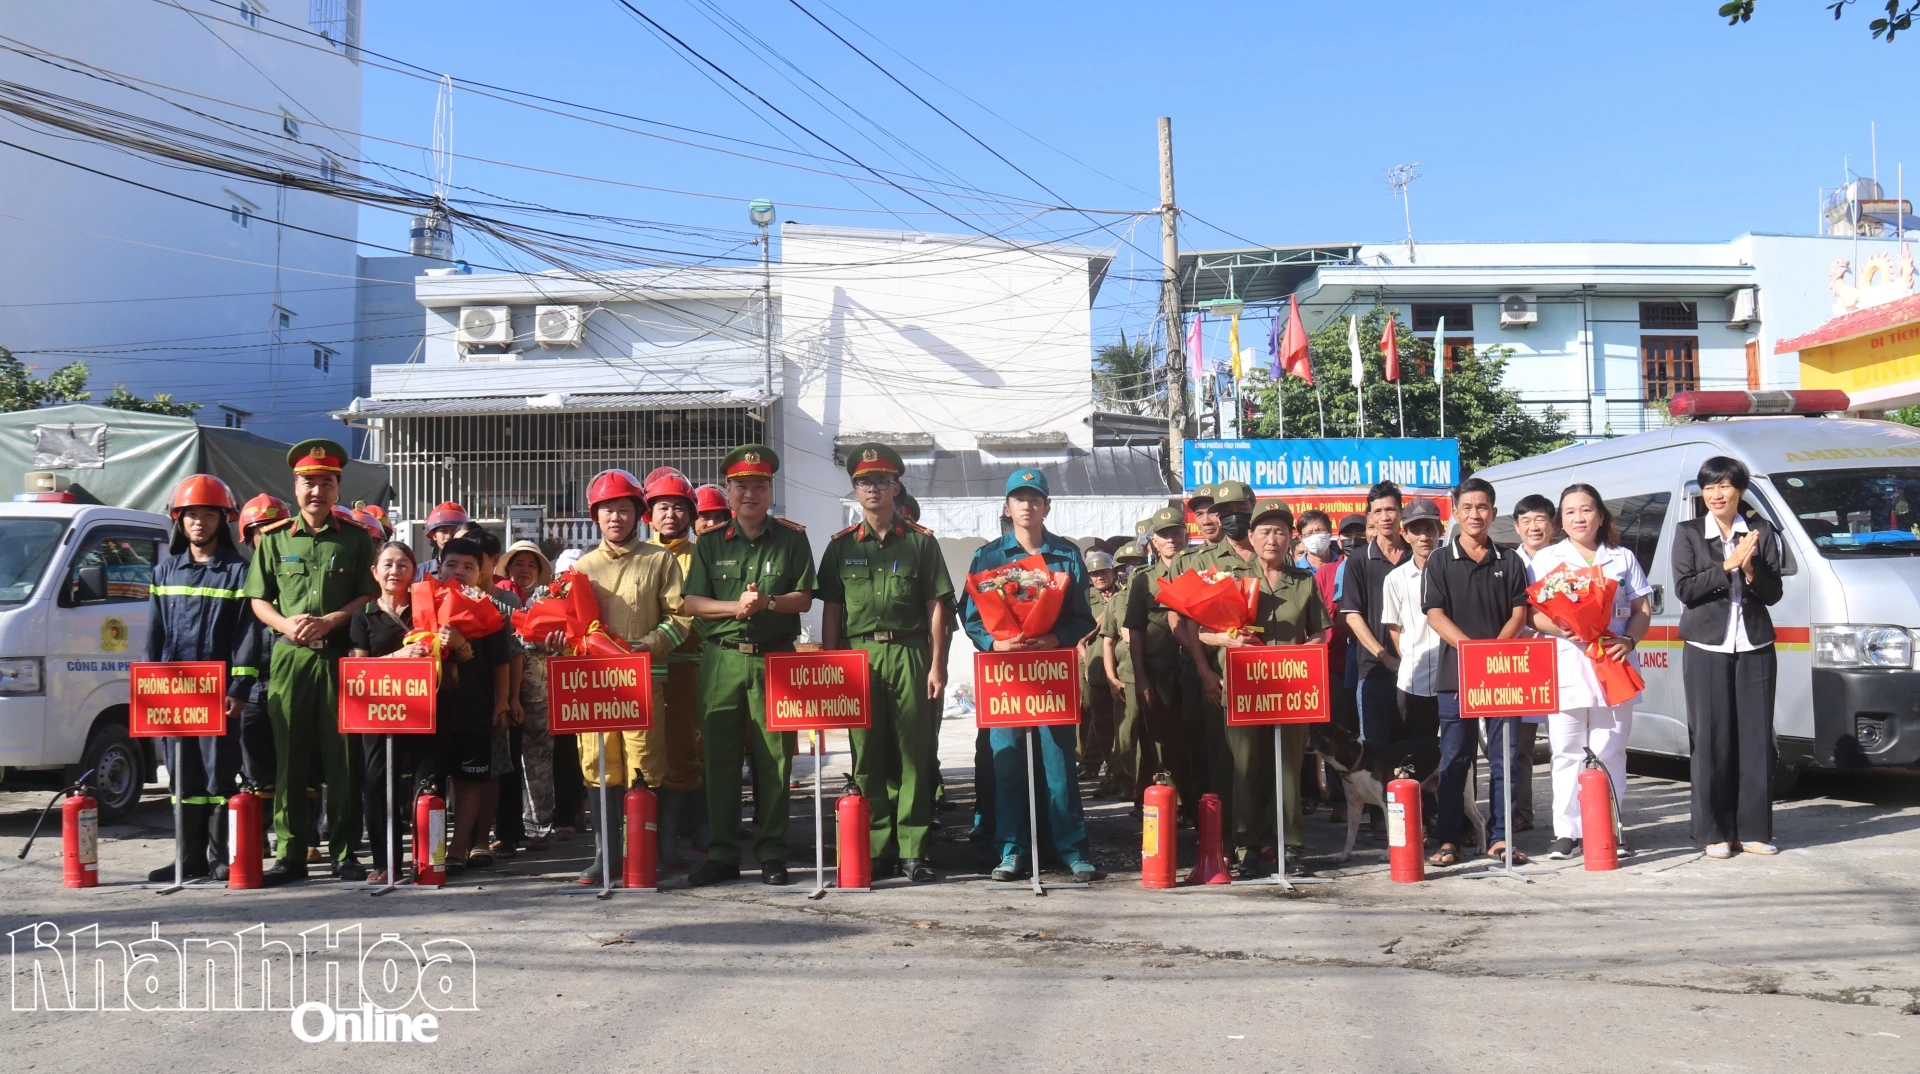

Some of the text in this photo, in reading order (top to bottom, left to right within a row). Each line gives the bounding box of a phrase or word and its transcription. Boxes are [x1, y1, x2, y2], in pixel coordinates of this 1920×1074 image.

[1193, 451, 1451, 485] TỔ DÂN PHỐ VĂN HÓA 1 BÌNH TÂN
[1786, 448, 1920, 462] AMBULAN
[1296, 501, 1313, 513] TÂN
[1319, 500, 1353, 513] PHƯỜNG
[1355, 502, 1368, 512] NA
[67, 659, 131, 672] CÔNG AN PH
[985, 659, 1069, 687] LỰC LƯỢNG
[1246, 657, 1308, 684] LỰC LƯỢNG
[1486, 645, 1530, 674] ĐOÀN THỂ
[1638, 652, 1668, 668] LANCE
[137, 670, 217, 695] PHÒNG CẢNH SÁT
[346, 669, 428, 697] TỔ LIÊN GIA
[561, 666, 637, 693] LỰC LƯỢNG
[790, 663, 845, 690] LỰC LƯỢNG
[776, 693, 860, 719] CÔNG AN PHƯỜNG
[989, 689, 1066, 717] DÂN QUÂN
[1237, 685, 1319, 713] BV ANTT CƠ SỞ
[1468, 680, 1492, 710] QUẦN
[1494, 682, 1523, 706] CHÚNG
[1531, 686, 1537, 704] Y
[1539, 679, 1551, 704] TẾ
[147, 706, 209, 725] PCCC & CNCH
[368, 703, 407, 721] PCCC
[561, 696, 640, 721] DÂN PHÒNG
